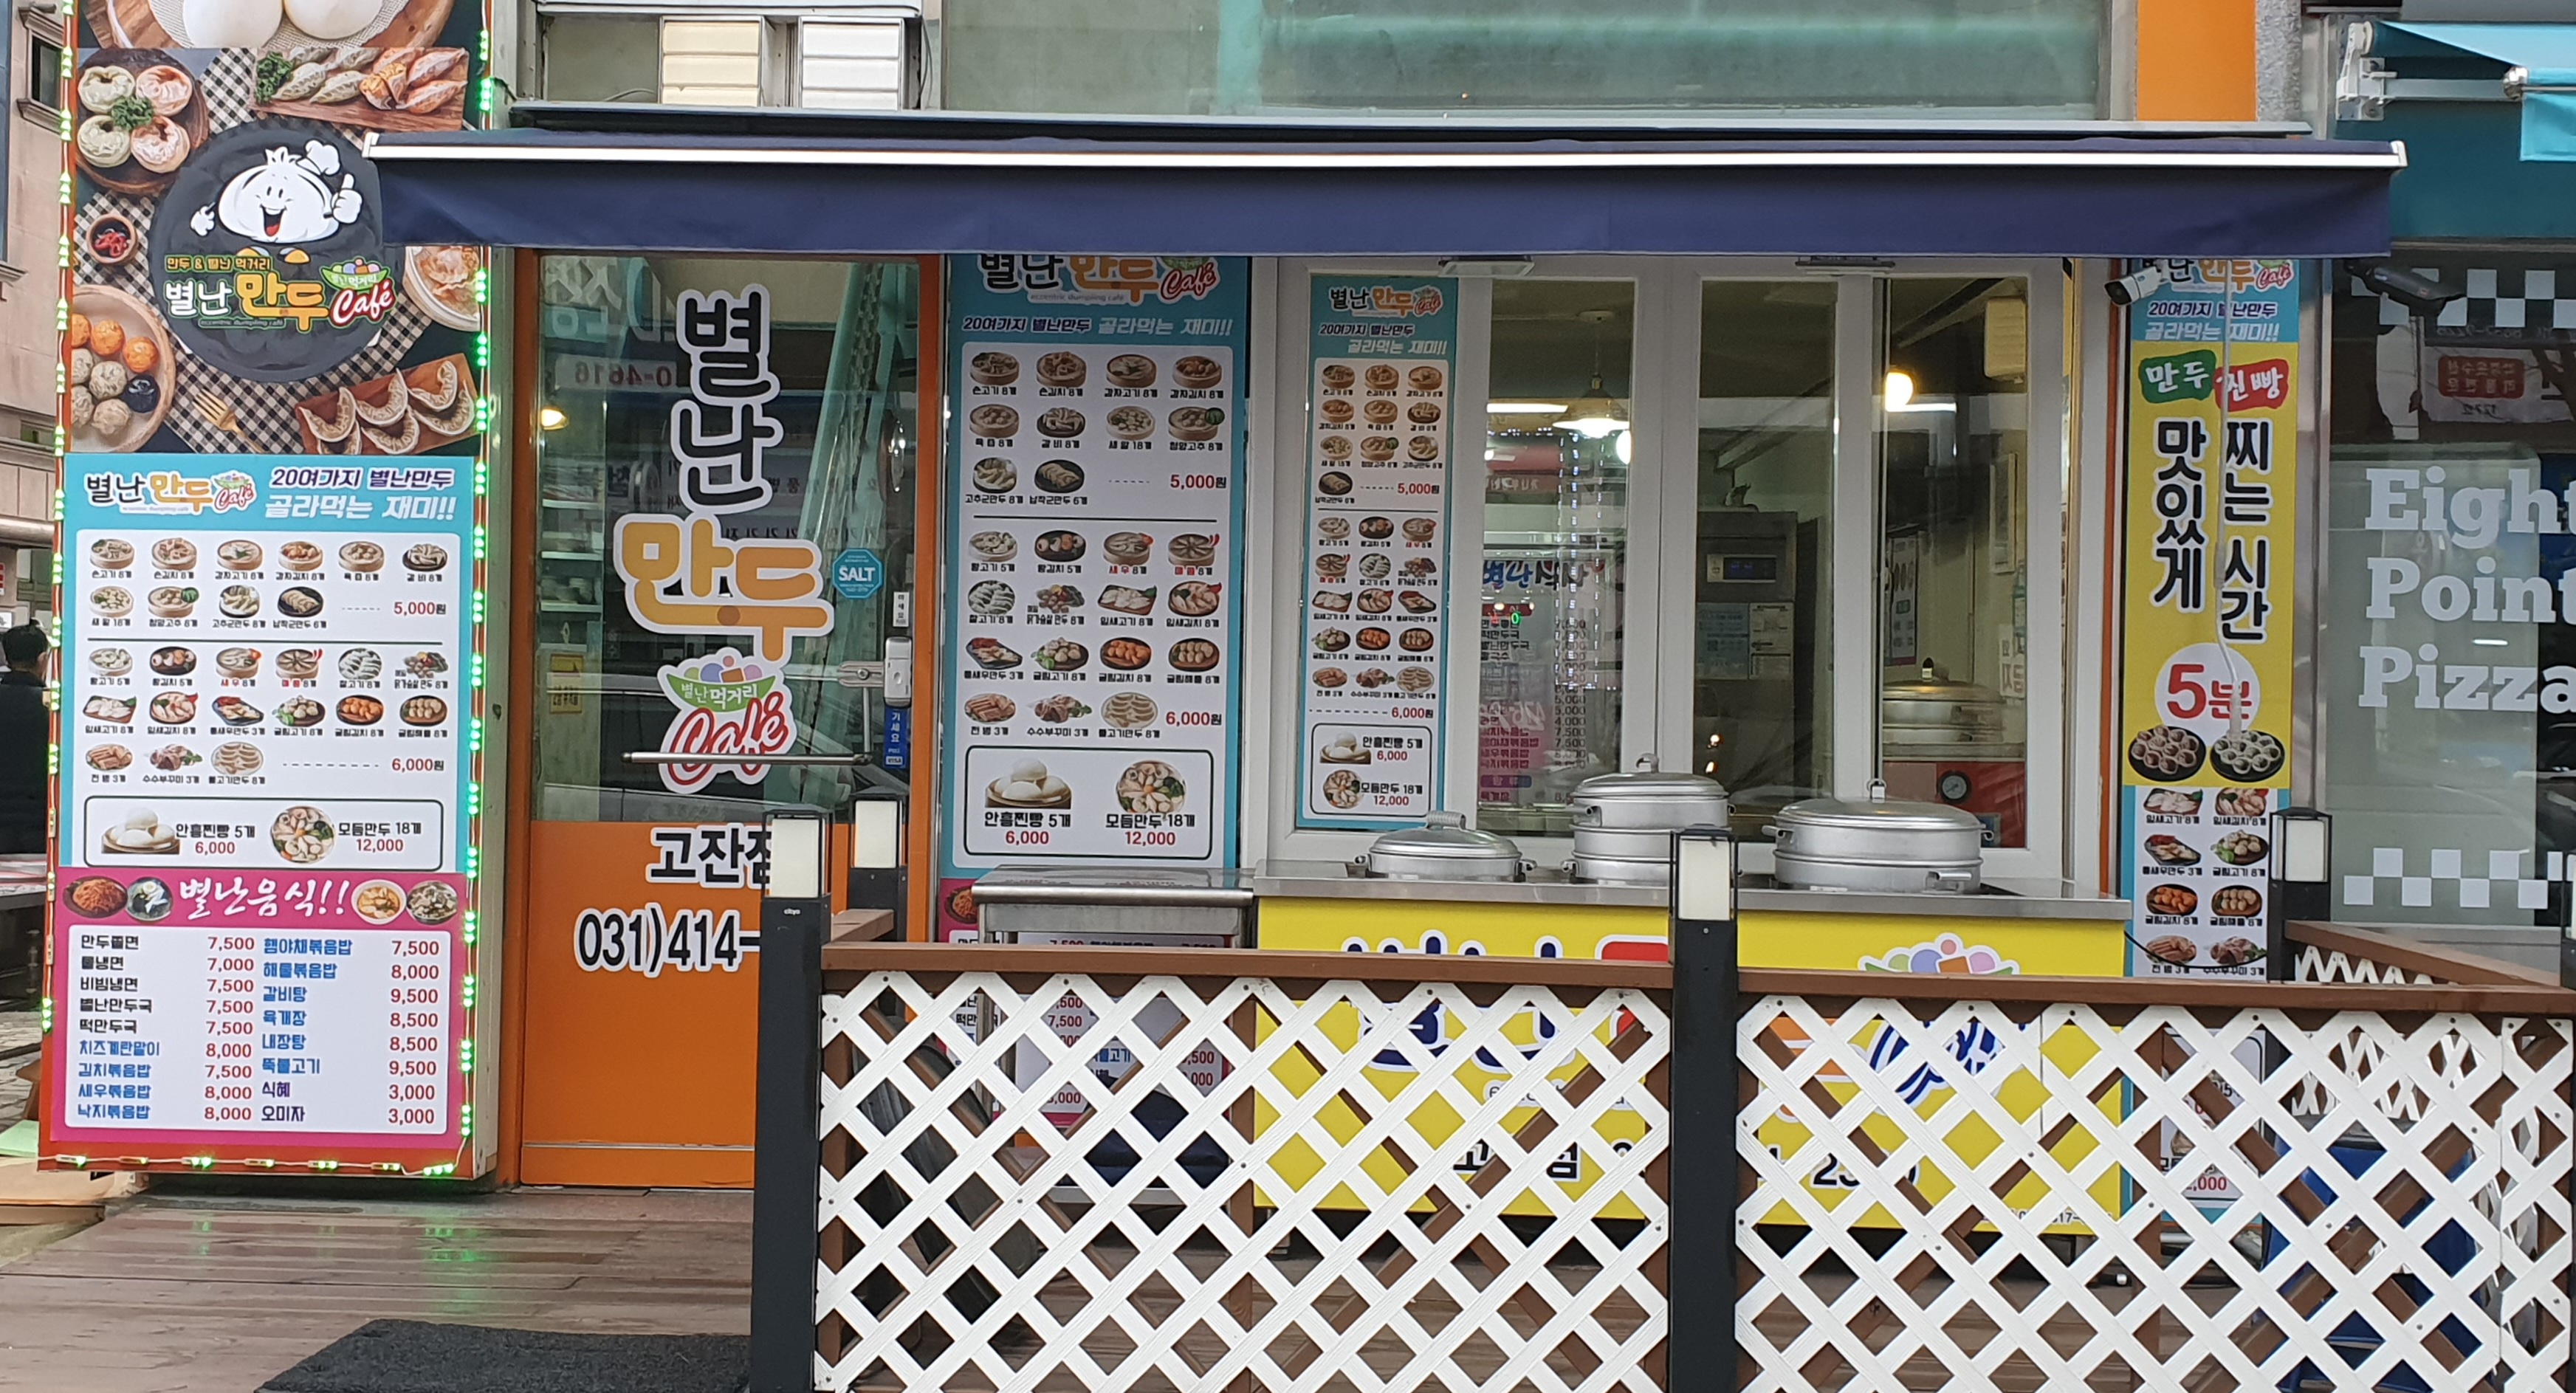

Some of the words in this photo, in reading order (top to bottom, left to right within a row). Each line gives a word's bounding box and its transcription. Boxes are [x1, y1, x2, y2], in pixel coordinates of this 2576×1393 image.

[195, 258, 203, 269] &
[236, 258, 270, 270] 먹거리
[980, 256, 1064, 290] 별난
[1070, 256, 1160, 303] 만두
[1161, 263, 1217, 300] Café
[2257, 264, 2292, 290] Café
[166, 281, 233, 316] 별난
[236, 273, 329, 331] 만두
[331, 280, 395, 326] Café
[1330, 289, 1370, 310] 별난
[1372, 287, 1414, 316] 만두
[2149, 302, 2212, 317] 20여가지
[963, 317, 1026, 331] 20여가지
[1032, 318, 1091, 333] 별난만두
[1098, 317, 1174, 336] 골라먹는
[1181, 319, 1233, 337] 재미!!
[2145, 322, 2222, 340] 골라먹는
[2146, 362, 2210, 393] 만두
[676, 288, 781, 510] 별난
[272, 469, 361, 487] 20여가지
[370, 470, 453, 489] 별난만두
[1170, 475, 1226, 489] 5,000원
[87, 475, 145, 503] 별난
[151, 475, 213, 512] 만두
[215, 484, 254, 511] Café
[265, 495, 374, 519] 골라먹는
[382, 496, 457, 520] 재미!!
[2154, 421, 2206, 609] 맛있게
[839, 568, 876, 582] SALT
[620, 517, 830, 662] 만두
[2222, 539, 2270, 639] 시간
[394, 602, 447, 616] 5,000원
[2359, 643, 2576, 713] Pizza
[681, 683, 708, 704] 별난
[710, 684, 758, 709] 먹거리
[2167, 664, 2252, 719] 5분
[1166, 712, 1222, 726] 6,000원
[667, 691, 789, 785] Café
[1407, 738, 1423, 749] 5개
[1377, 750, 1407, 761] 6,000
[392, 758, 444, 772] 6,000원
[1404, 785, 1423, 794] 18개
[1374, 795, 1409, 806] 12,000
[337, 821, 391, 836] 모듬만두
[396, 822, 422, 836] 18개
[984, 812, 1043, 828] 안흥찐빵
[1048, 813, 1071, 828] 5개
[1105, 813, 1162, 829] 모듬만두
[1169, 814, 1195, 828] 18개
[176, 823, 230, 839] 안흥찐빵
[236, 825, 255, 839] 5개
[1005, 830, 1049, 846] 6,000
[1124, 831, 1176, 847] 12,000
[195, 841, 236, 856] 6,000
[356, 839, 404, 853] 12,000
[179, 877, 350, 921] 별난음식!!
[81, 935, 140, 949] 만두쫄면
[207, 936, 255, 952] 7,500
[264, 938, 353, 955] 햄야채볶음밥
[391, 940, 440, 957] 7,500
[81, 956, 124, 970] 물냉면
[207, 957, 254, 973] 7,000
[264, 962, 338, 978] 해물볶음밥
[391, 965, 439, 981] 8,000
[80, 977, 139, 991] 비빔냉면
[207, 979, 254, 994] 7,500
[263, 986, 308, 1002] 갈비탕
[390, 988, 439, 1005] 9,500
[80, 998, 153, 1013] 별난만두국
[206, 1000, 253, 1016] 7,500
[80, 1019, 137, 1033] 떡만두국
[206, 1021, 253, 1036] 7,500
[263, 1009, 307, 1025] 육개장
[390, 1012, 439, 1028] 8,500
[1047, 1015, 1082, 1028] 7,500
[79, 1041, 160, 1056] 치즈계란말이
[205, 1043, 253, 1060] 8,000
[262, 1033, 306, 1050] 내장탕
[390, 1036, 438, 1053] 8,500
[78, 1063, 151, 1078] 김치볶음밥
[205, 1064, 253, 1081] 7,500
[261, 1057, 321, 1073] 뚝불고기
[389, 1061, 437, 1077] 9,500
[78, 1084, 151, 1098] 새우볶음밥
[205, 1085, 252, 1101] 8,000
[261, 1081, 290, 1097] 식혜
[388, 1084, 436, 1101] 3,000
[78, 1104, 151, 1118] 낙지볶음밥
[204, 1107, 252, 1123] 8,000
[261, 1106, 305, 1122] 오미자
[388, 1109, 435, 1126] 3,000
